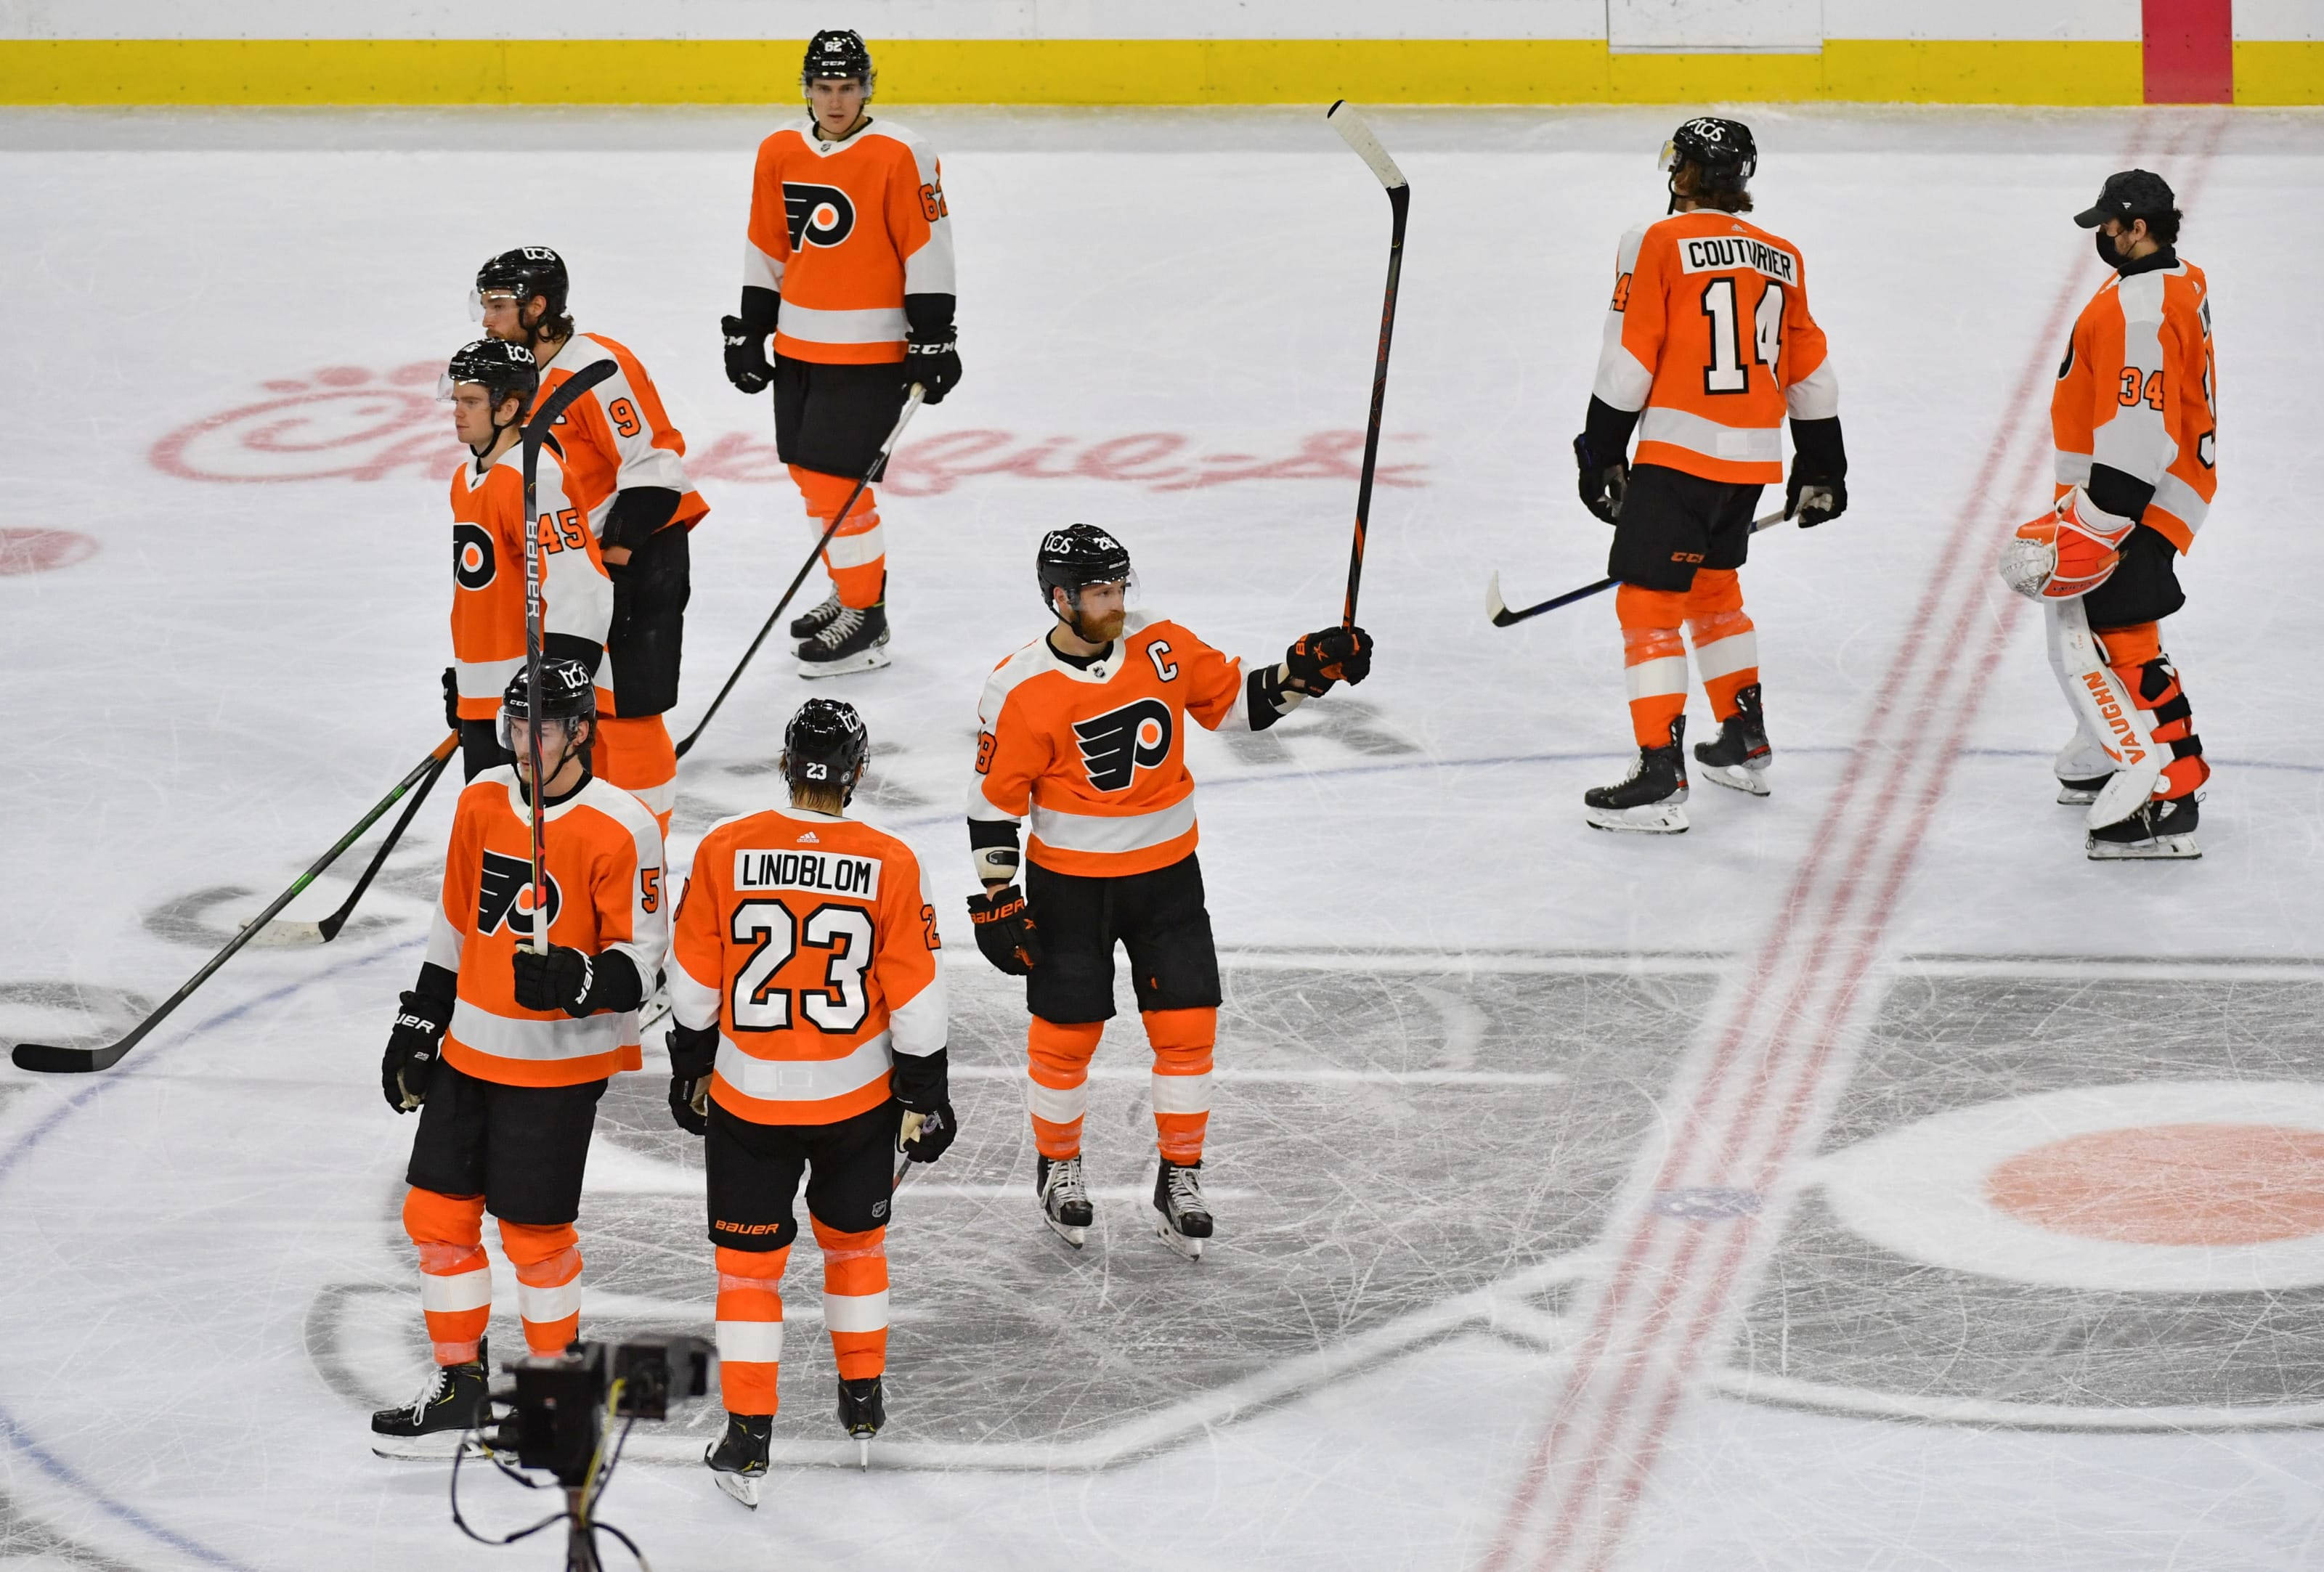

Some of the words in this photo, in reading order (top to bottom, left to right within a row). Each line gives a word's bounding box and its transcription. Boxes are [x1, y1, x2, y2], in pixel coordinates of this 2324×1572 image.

[824, 41, 843, 52] 62
[1688, 238, 1792, 282] COUTURIER
[1612, 272, 1633, 312] 4
[908, 341, 955, 355] CCM
[1700, 276, 1786, 396] 14
[2117, 366, 2163, 412] 34
[608, 396, 642, 439] 9
[536, 508, 588, 555] 45
[1145, 639, 1179, 683] C
[2081, 670, 2146, 765] VAUGHN
[806, 762, 827, 780] 23
[742, 854, 872, 895] LINDBLOM
[730, 897, 876, 1035] 23
